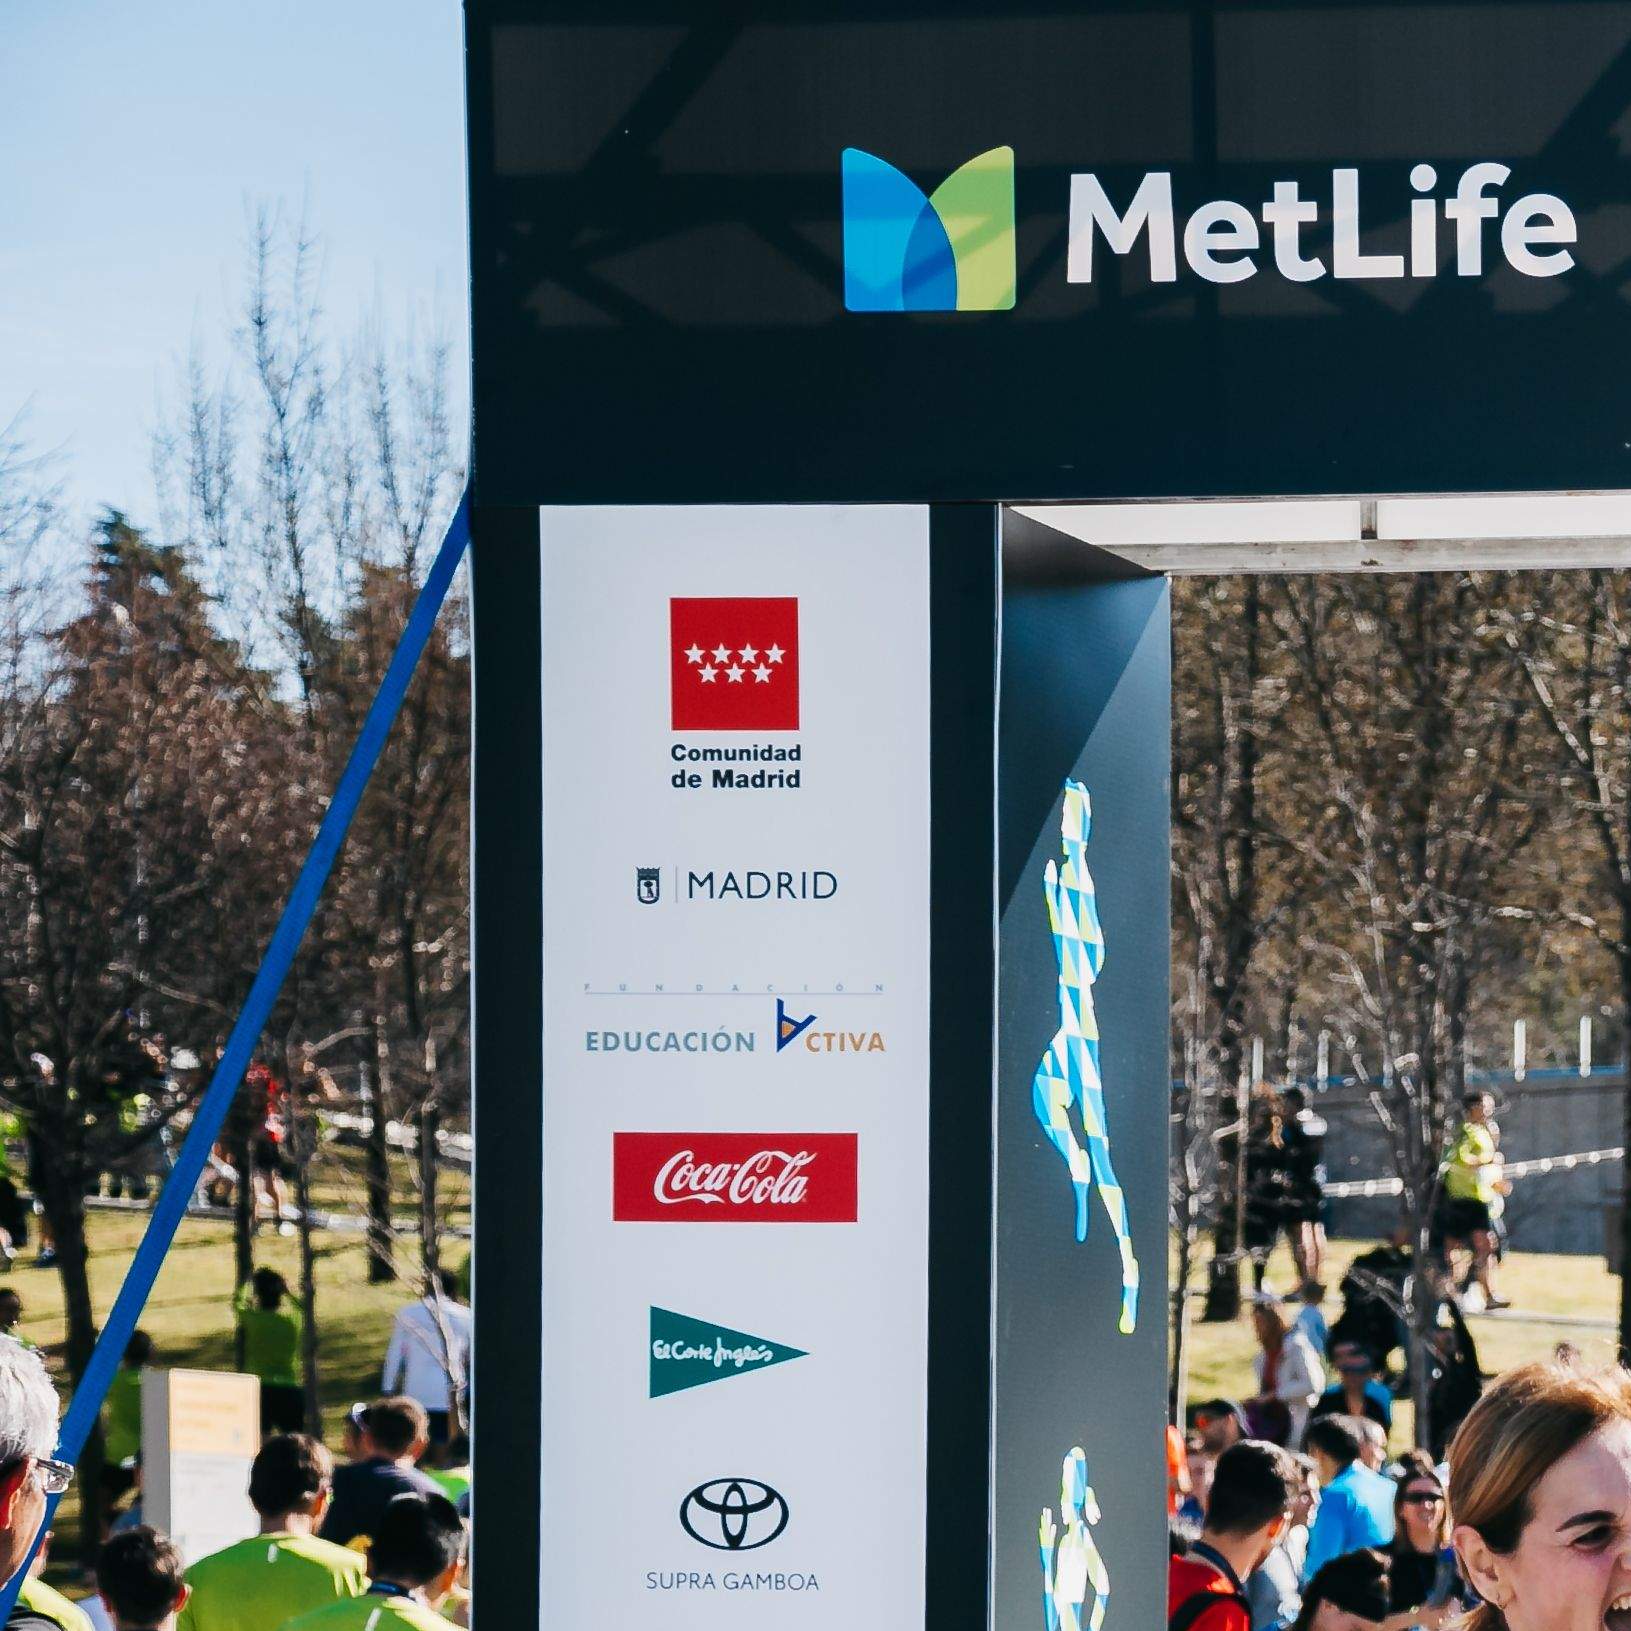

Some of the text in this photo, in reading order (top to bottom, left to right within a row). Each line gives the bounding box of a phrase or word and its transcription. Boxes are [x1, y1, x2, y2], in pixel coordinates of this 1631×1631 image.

[1066, 162, 1577, 283] MetLife
[671, 744, 801, 762] Comunidad
[671, 766, 800, 790] de Madrid
[688, 871, 838, 899] MADRID
[585, 1025, 755, 1052] EDUCACIÓN
[653, 1150, 817, 1204] Coca-Cola
[653, 1337, 773, 1367] El Corte Inglés
[647, 1572, 819, 1590] SUPRA GAMBOA
